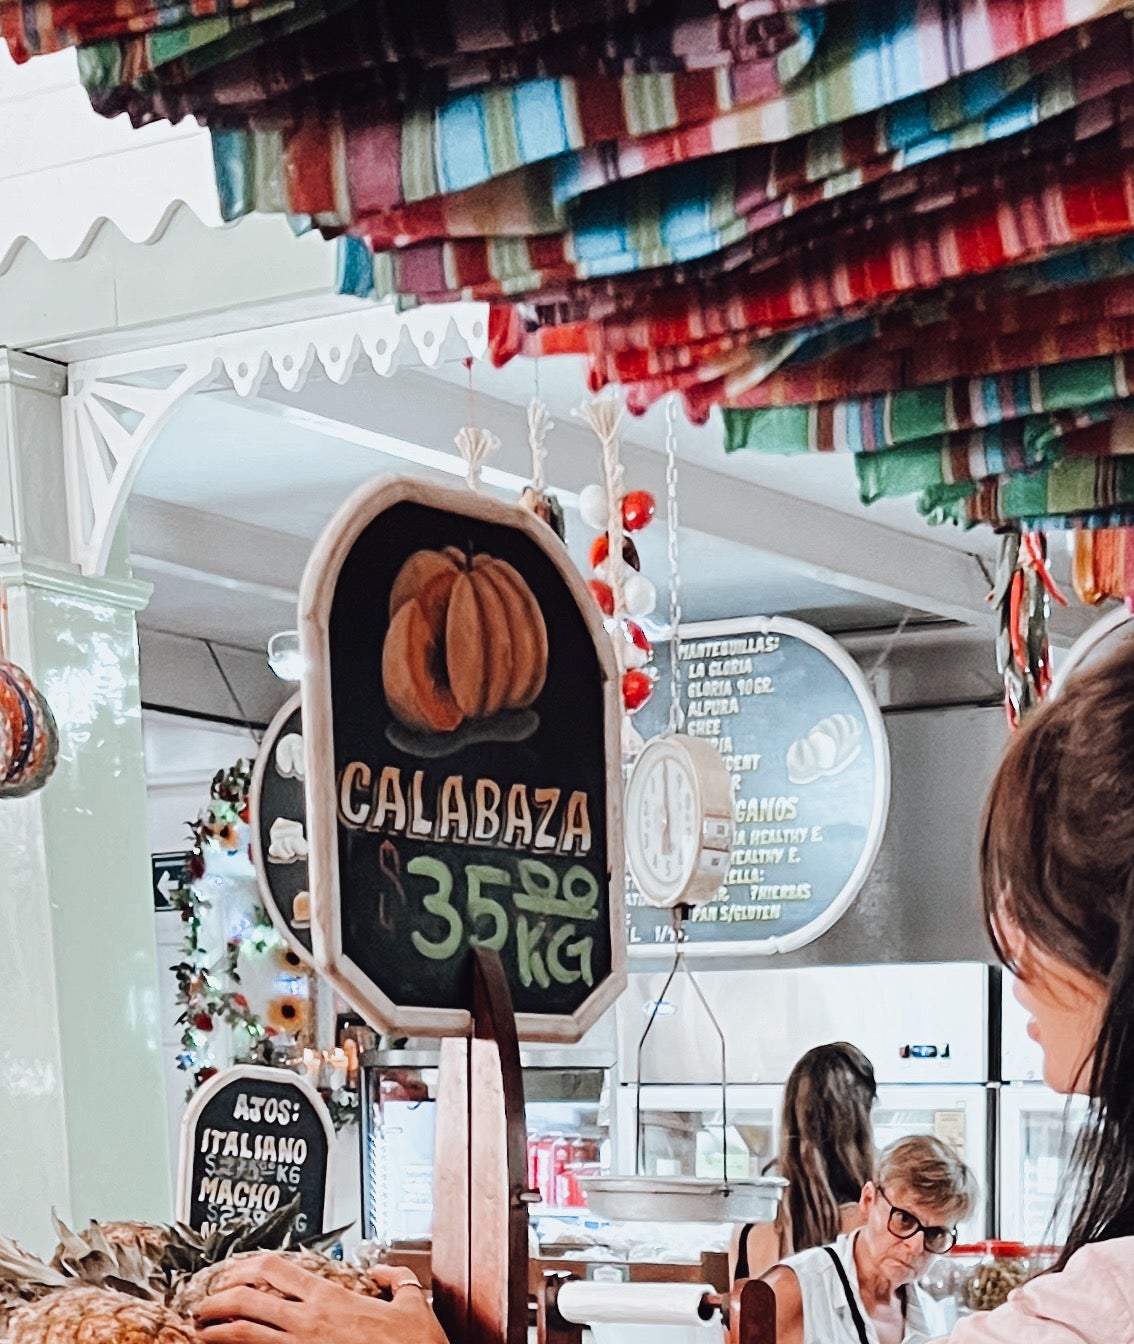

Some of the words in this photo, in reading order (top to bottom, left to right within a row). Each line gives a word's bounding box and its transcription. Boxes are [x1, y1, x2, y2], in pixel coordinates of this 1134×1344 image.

[688, 662, 706, 679] LA
[708, 658, 753, 677] GLORIA
[687, 680, 733, 698] GLORIA
[687, 698, 739, 717] ALPURA
[338, 761, 593, 856] CALABAZA
[734, 797, 799, 823] GANOS
[731, 848, 785, 865] EALTHY
[692, 905, 718, 922] PAN
[516, 915, 594, 988] KG
[233, 1093, 300, 1126] AJOS:
[200, 1128, 308, 1165] ITALIANO
[198, 1176, 281, 1212] MACHO
